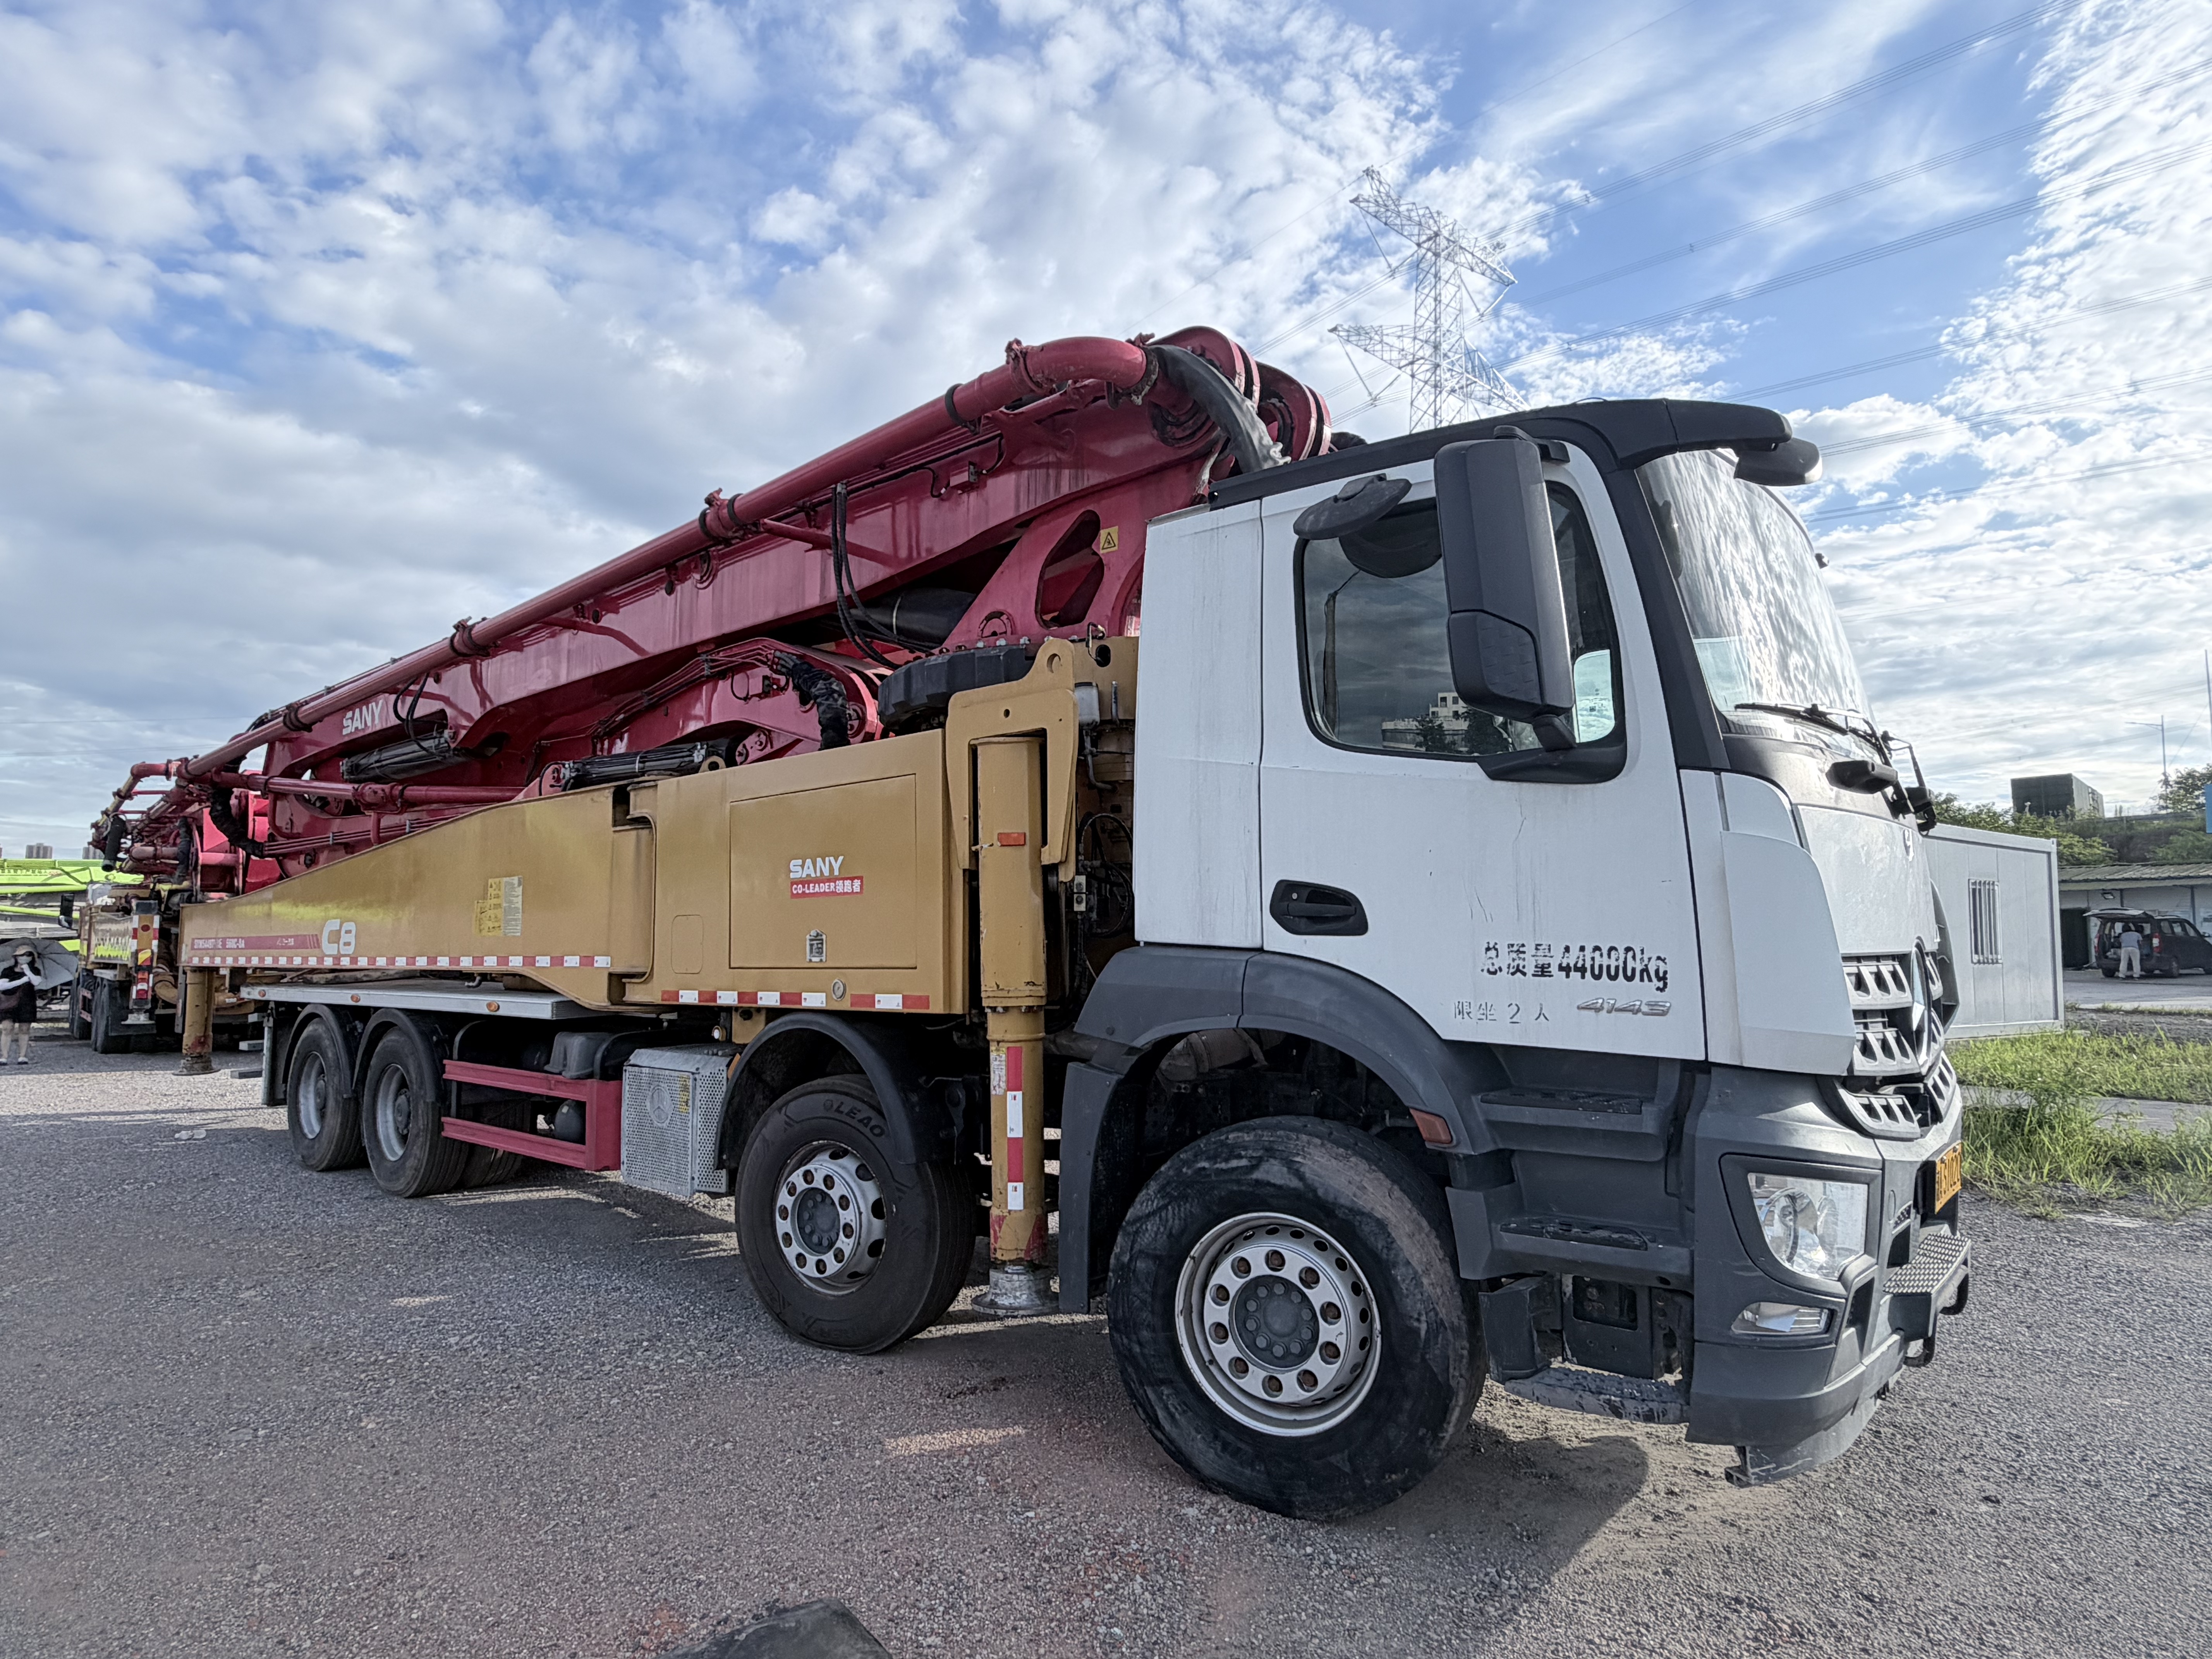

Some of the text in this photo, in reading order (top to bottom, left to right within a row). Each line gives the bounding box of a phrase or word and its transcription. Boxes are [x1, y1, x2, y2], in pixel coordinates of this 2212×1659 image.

[343, 699, 383, 735] SANY
[790, 856, 844, 878] SANY
[322, 919, 356, 955] C8
[1577, 997, 1671, 1016] 4143
[835, 1101, 885, 1137] LEAO
